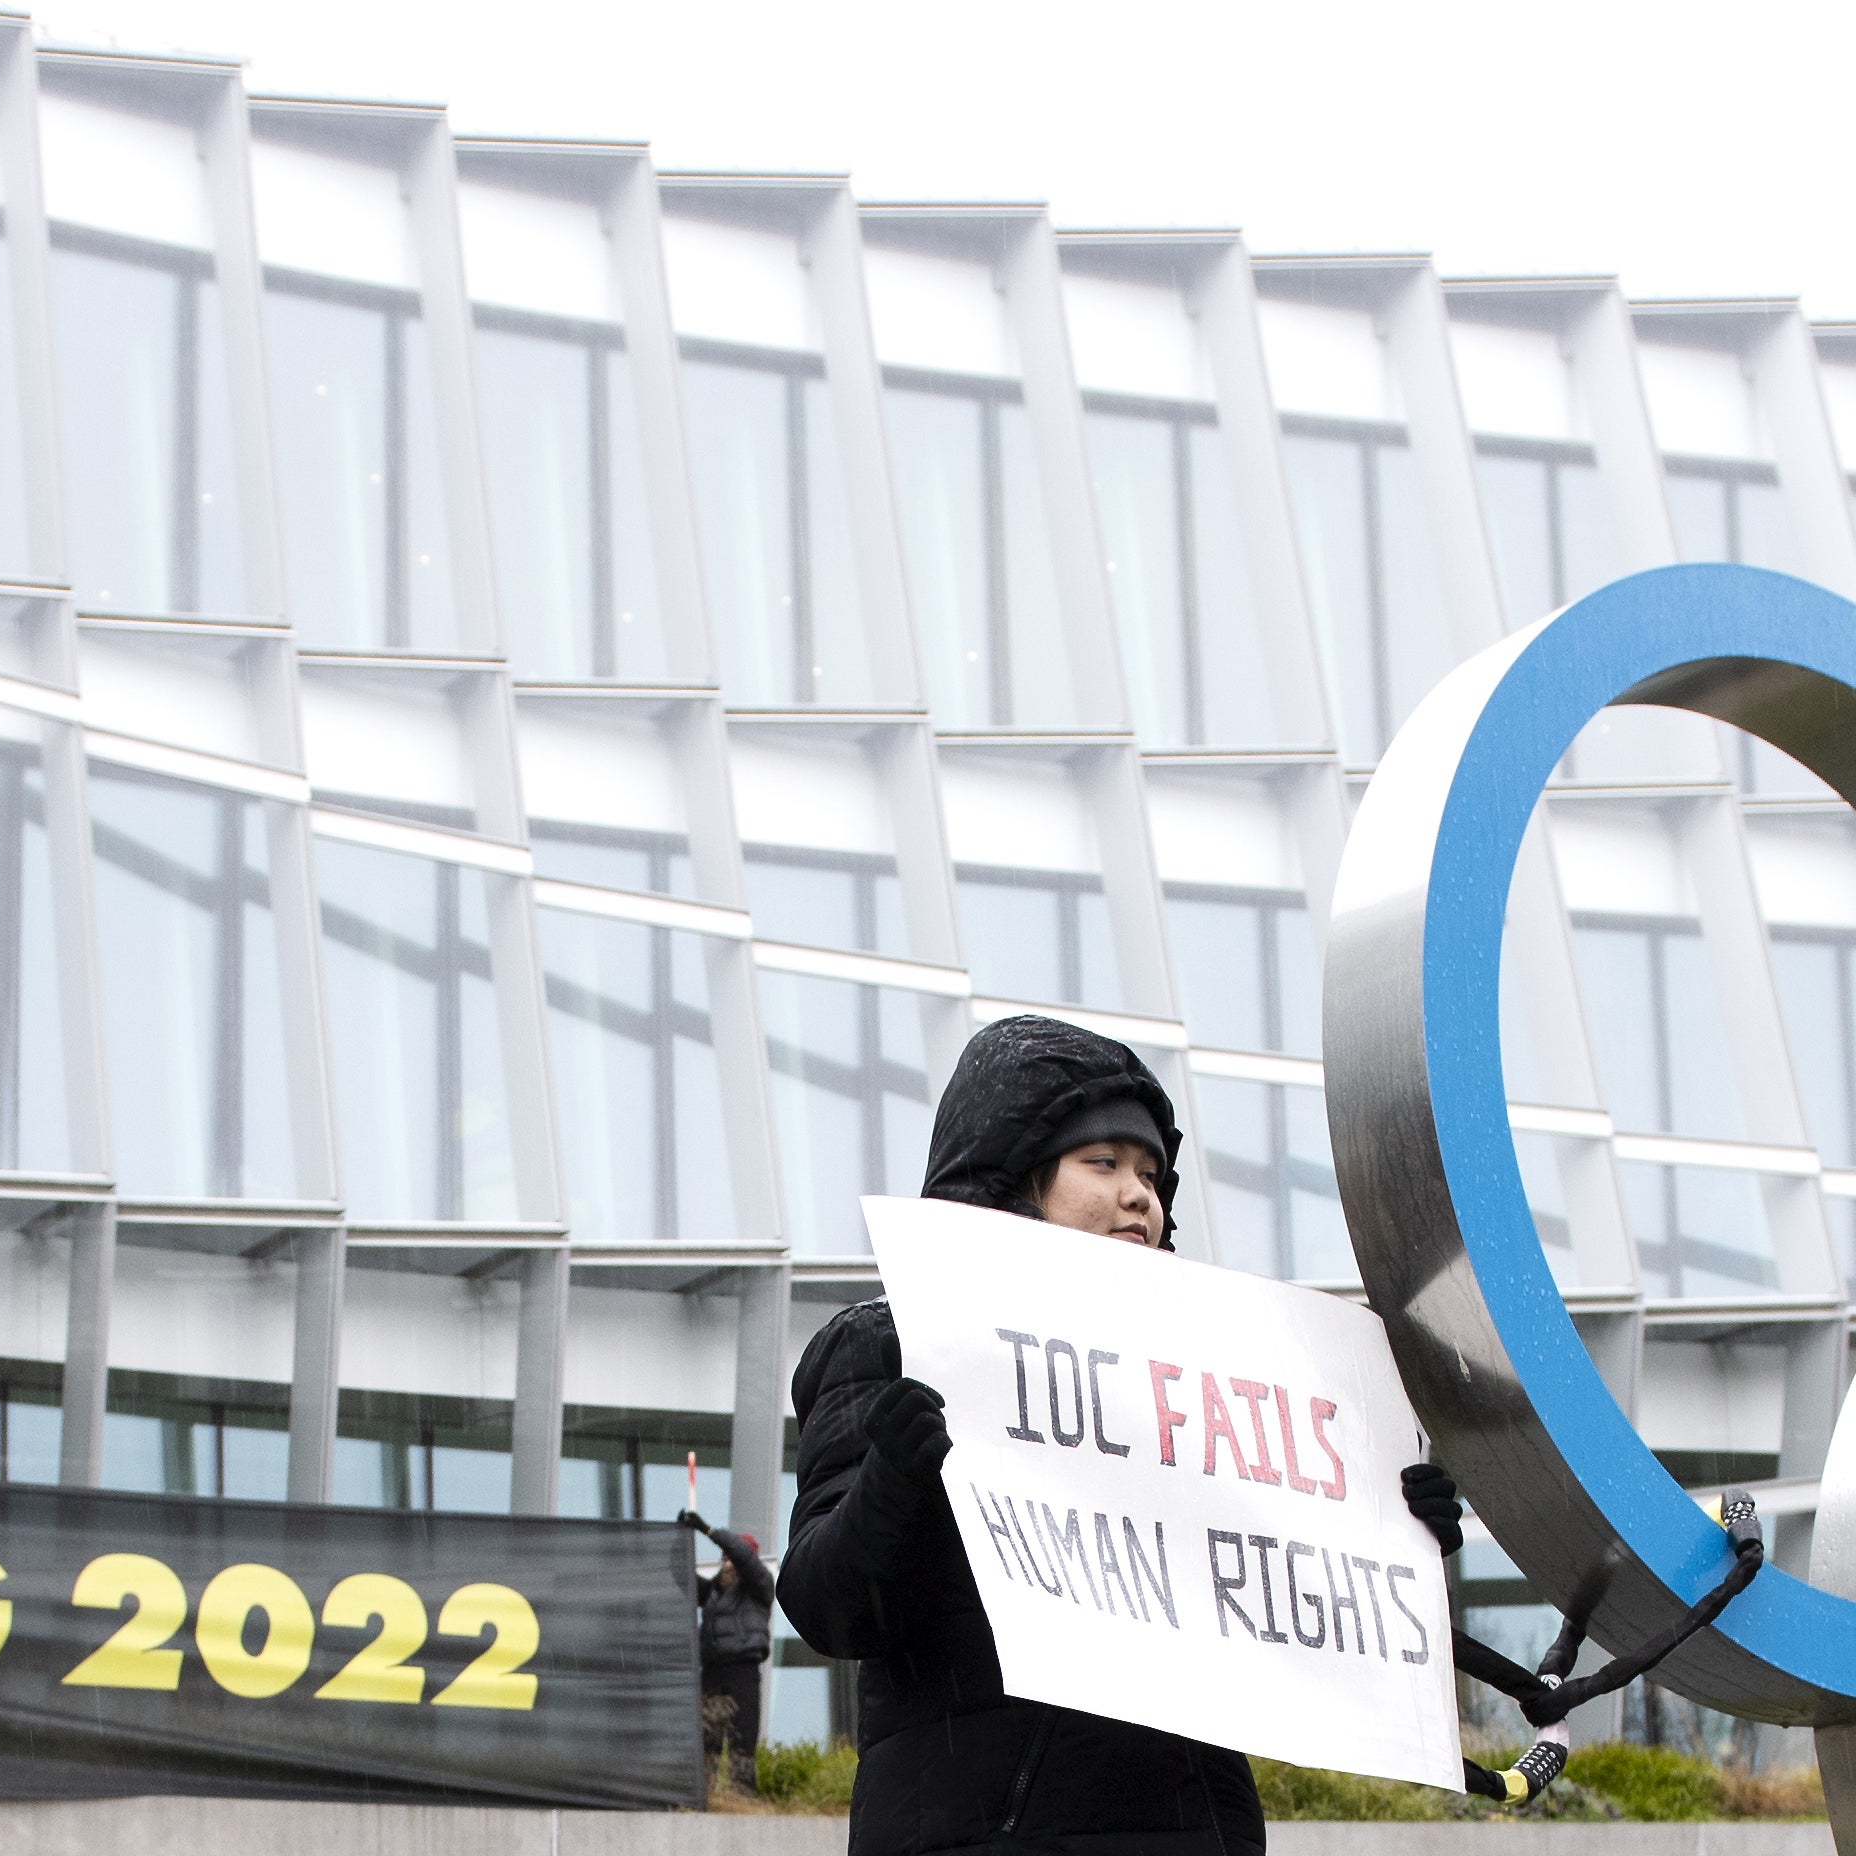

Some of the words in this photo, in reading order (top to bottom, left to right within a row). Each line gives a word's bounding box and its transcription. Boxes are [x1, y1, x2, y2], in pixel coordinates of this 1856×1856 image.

[995, 1327, 1132, 1459] IOC
[1148, 1358, 1347, 1502] FAILS
[60, 1552, 540, 1710] 2022
[968, 1482, 1180, 1630] HUMAN
[1207, 1527, 1430, 1667] RIGHTS
